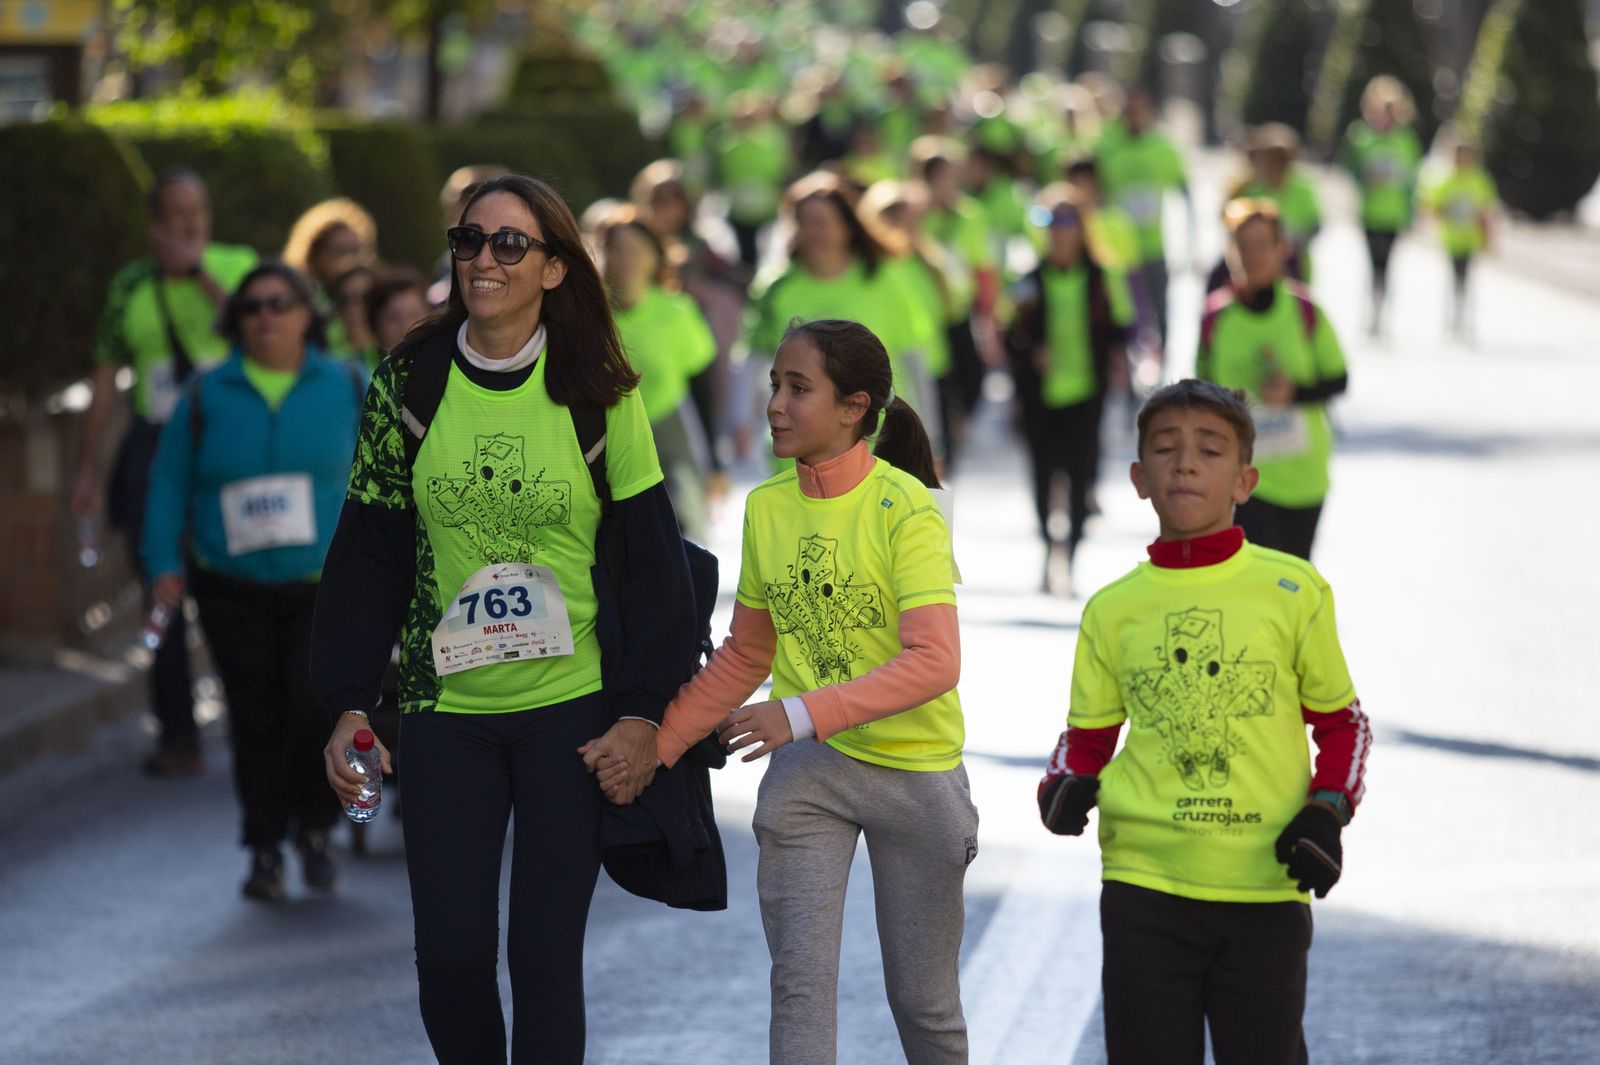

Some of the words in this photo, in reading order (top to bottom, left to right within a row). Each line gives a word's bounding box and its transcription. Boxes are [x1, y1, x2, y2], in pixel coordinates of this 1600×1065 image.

[459, 586, 532, 625] 763
[483, 623, 518, 635] MARTA
[1177, 797, 1233, 808] carrera
[1172, 810, 1262, 827] cruzroja.es
